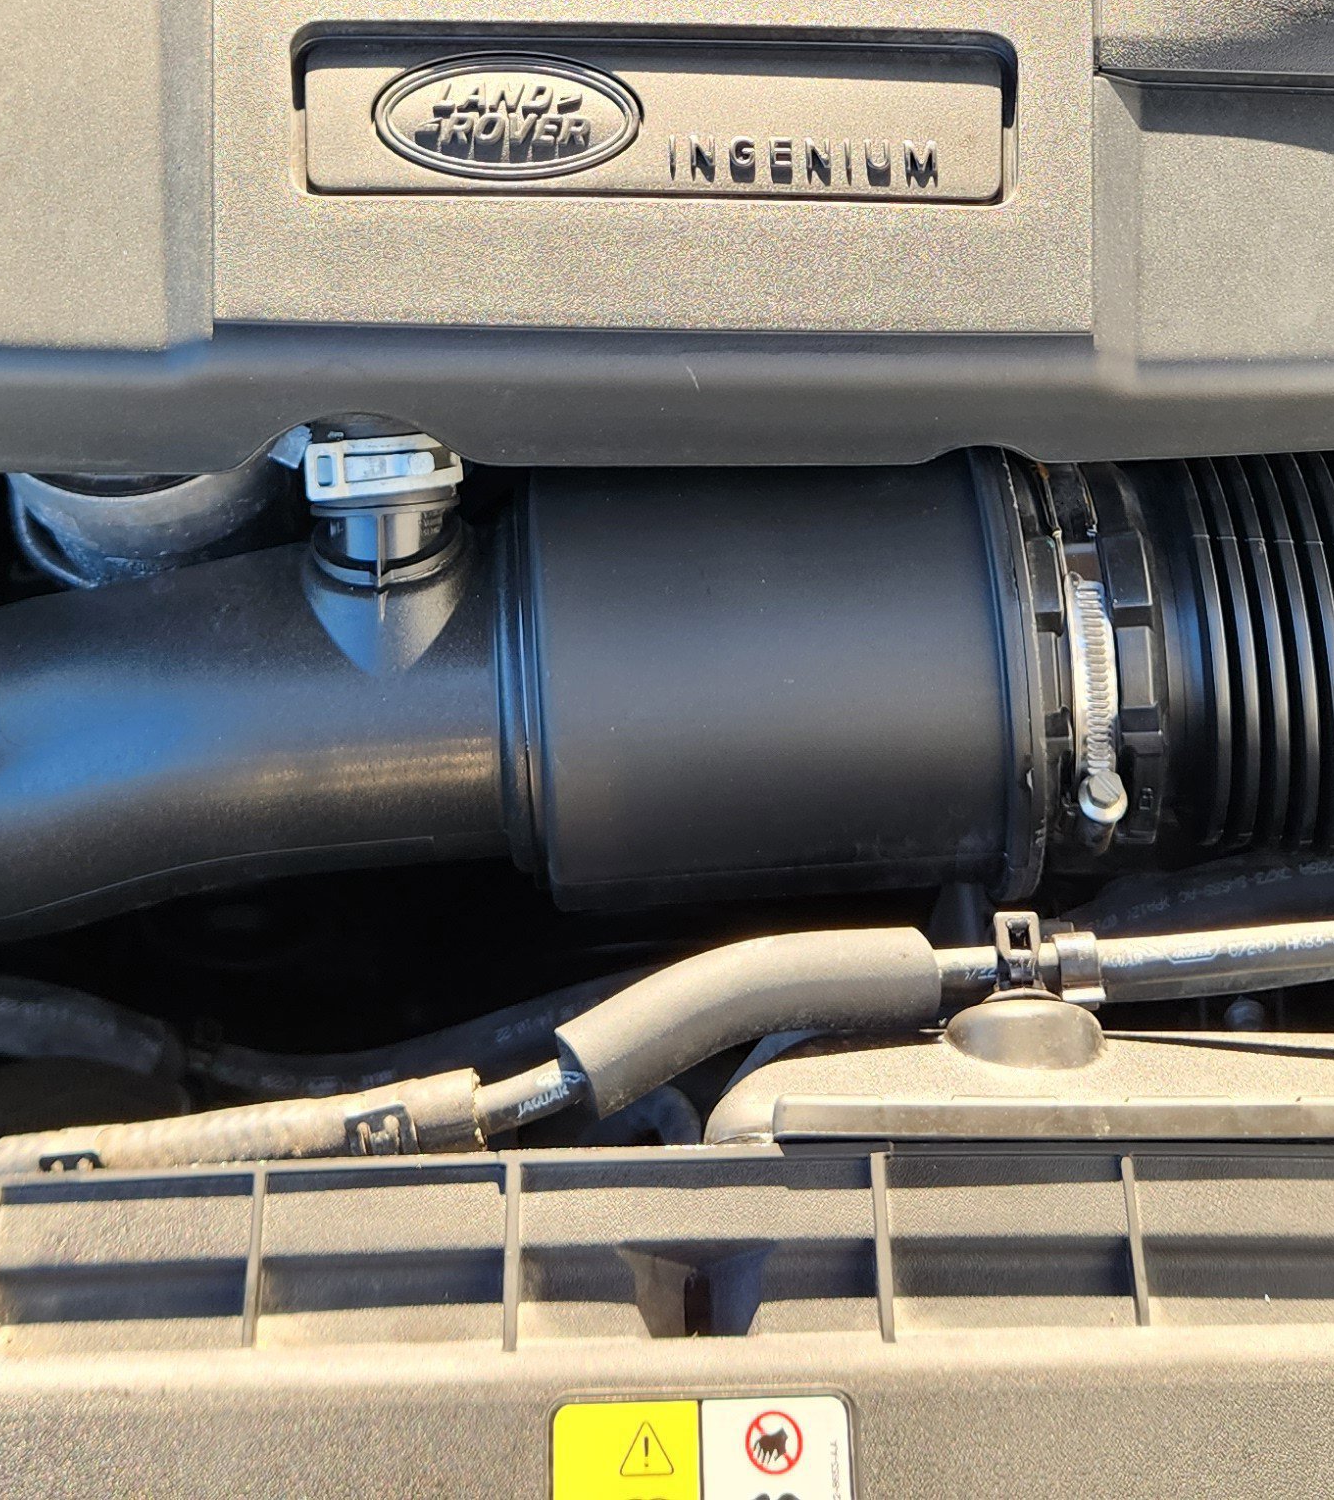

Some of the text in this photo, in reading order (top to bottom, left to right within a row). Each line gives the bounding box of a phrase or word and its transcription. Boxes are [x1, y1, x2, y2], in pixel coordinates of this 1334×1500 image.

[435, 80, 553, 114] LAND
[437, 111, 592, 150] ROVER
[668, 135, 940, 187] INGENIUM
